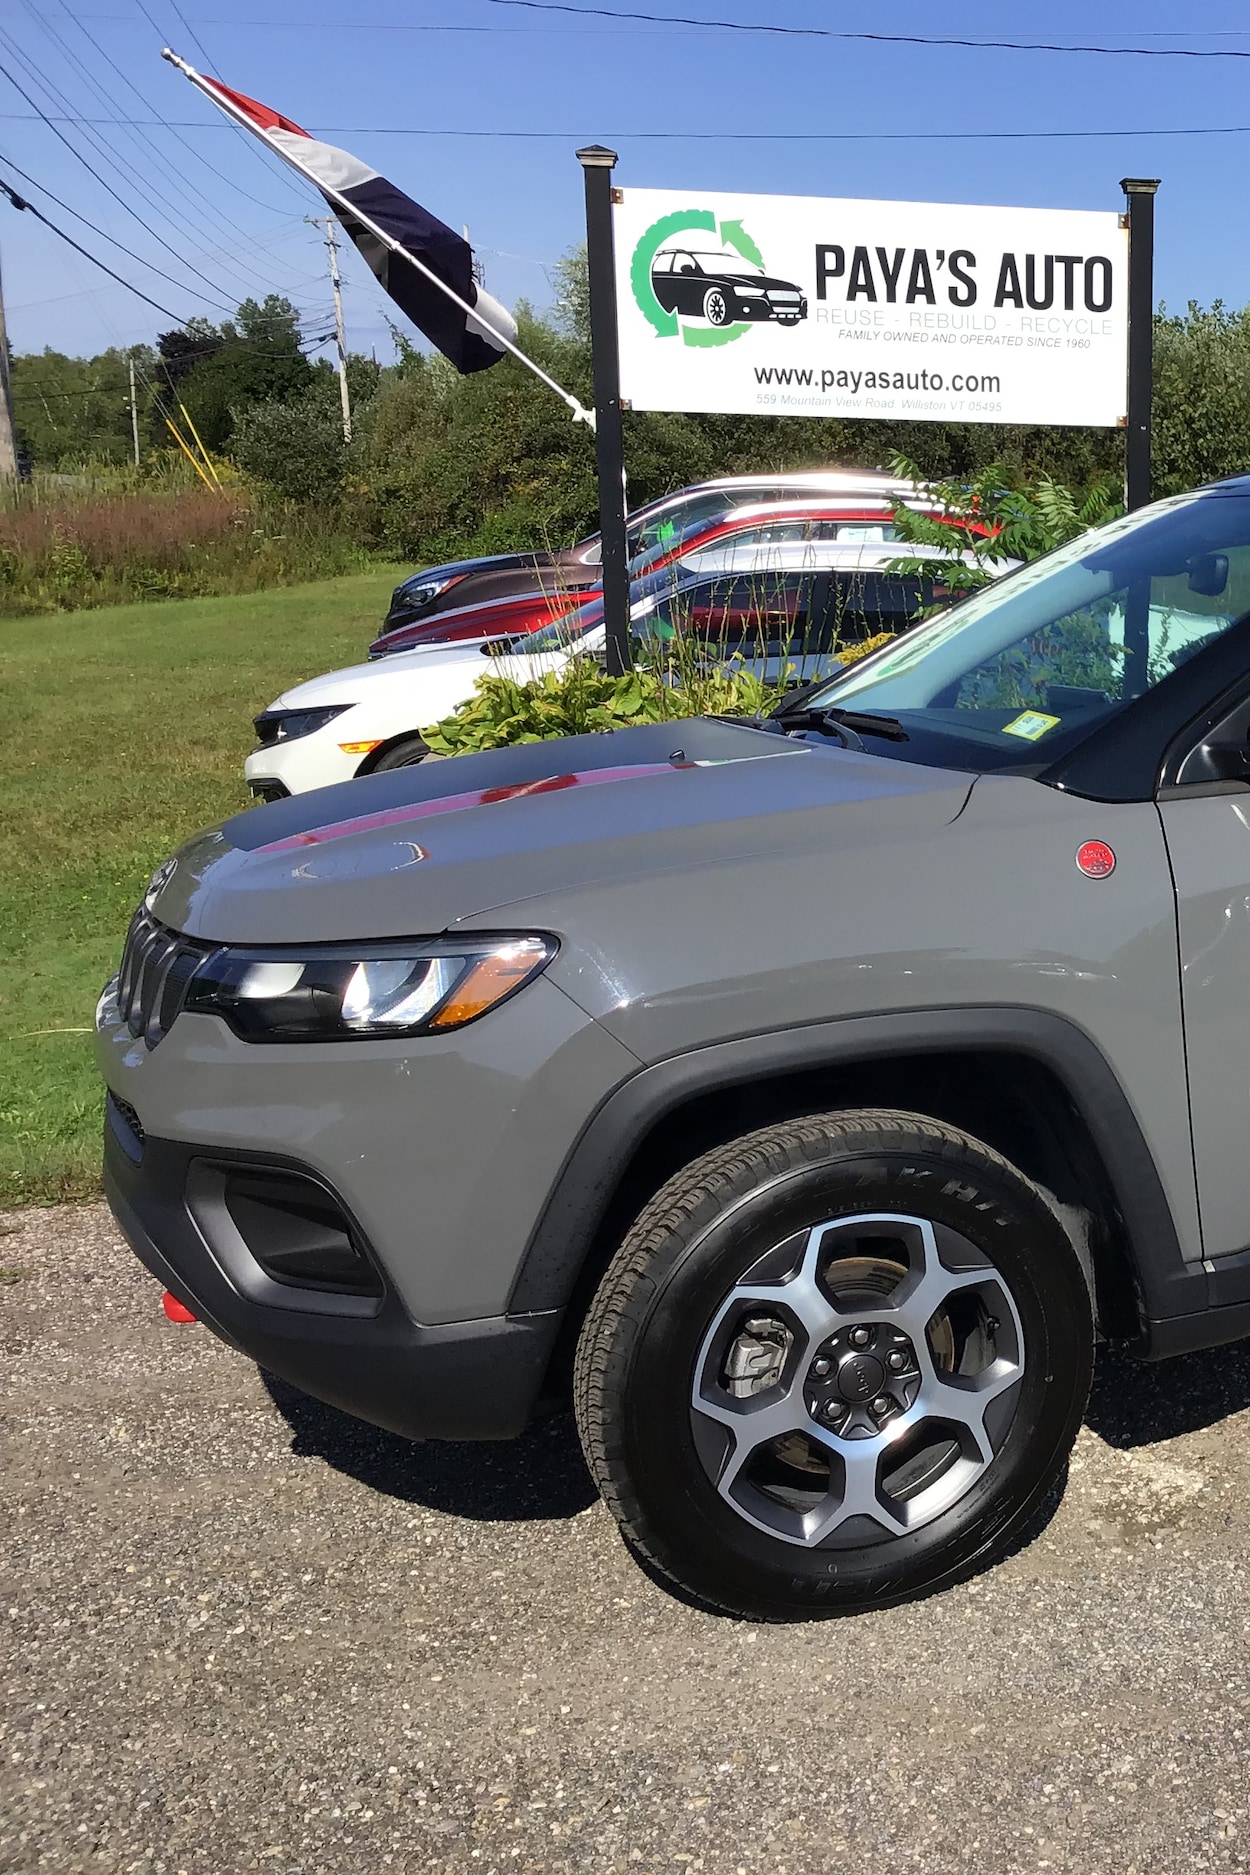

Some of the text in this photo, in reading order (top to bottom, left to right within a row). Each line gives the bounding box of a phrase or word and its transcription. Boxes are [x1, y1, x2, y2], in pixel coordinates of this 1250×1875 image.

[815, 243, 1113, 313] PAYA'S AUTO
[816, 307, 885, 326] REUSE
[909, 312, 997, 331] REBUILD
[1020, 316, 1113, 336] RECYCLE
[837, 329, 1091, 349] FAMILY OWNED AND OPERATED SINCE 1960
[753, 367, 1001, 394] www.payasauto.com
[756, 393, 777, 405] 559
[780, 394, 832, 407] Mountain
[835, 396, 862, 408] View
[900, 399, 947, 411] Williston
[950, 400, 965, 411] VT
